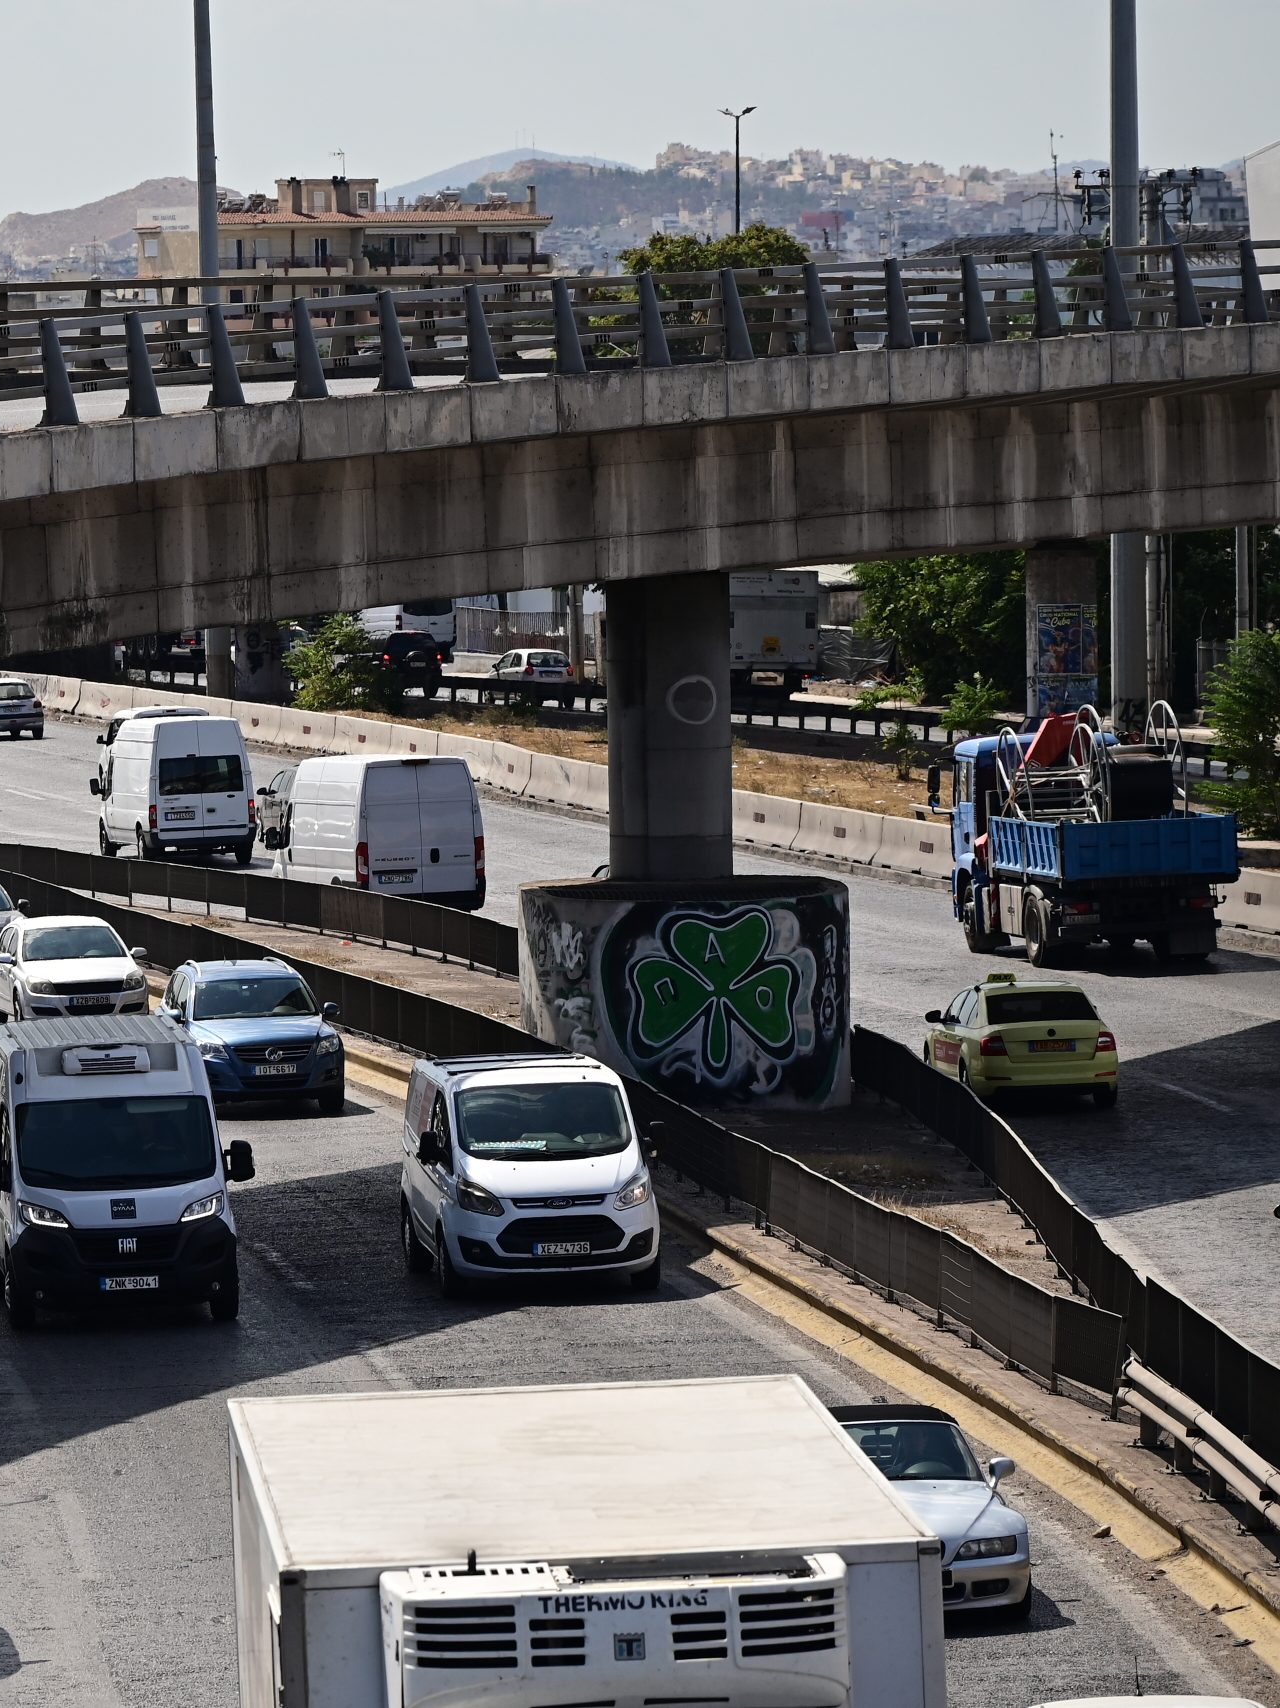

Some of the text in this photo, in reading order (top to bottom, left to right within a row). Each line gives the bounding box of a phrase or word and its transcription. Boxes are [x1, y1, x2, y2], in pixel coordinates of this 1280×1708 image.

[258, 1065, 296, 1075] IOT-6617
[118, 1238, 137, 1254] FIAT
[539, 1242, 589, 1255] XEZ-4736
[107, 1276, 158, 1290] ZNK-9041
